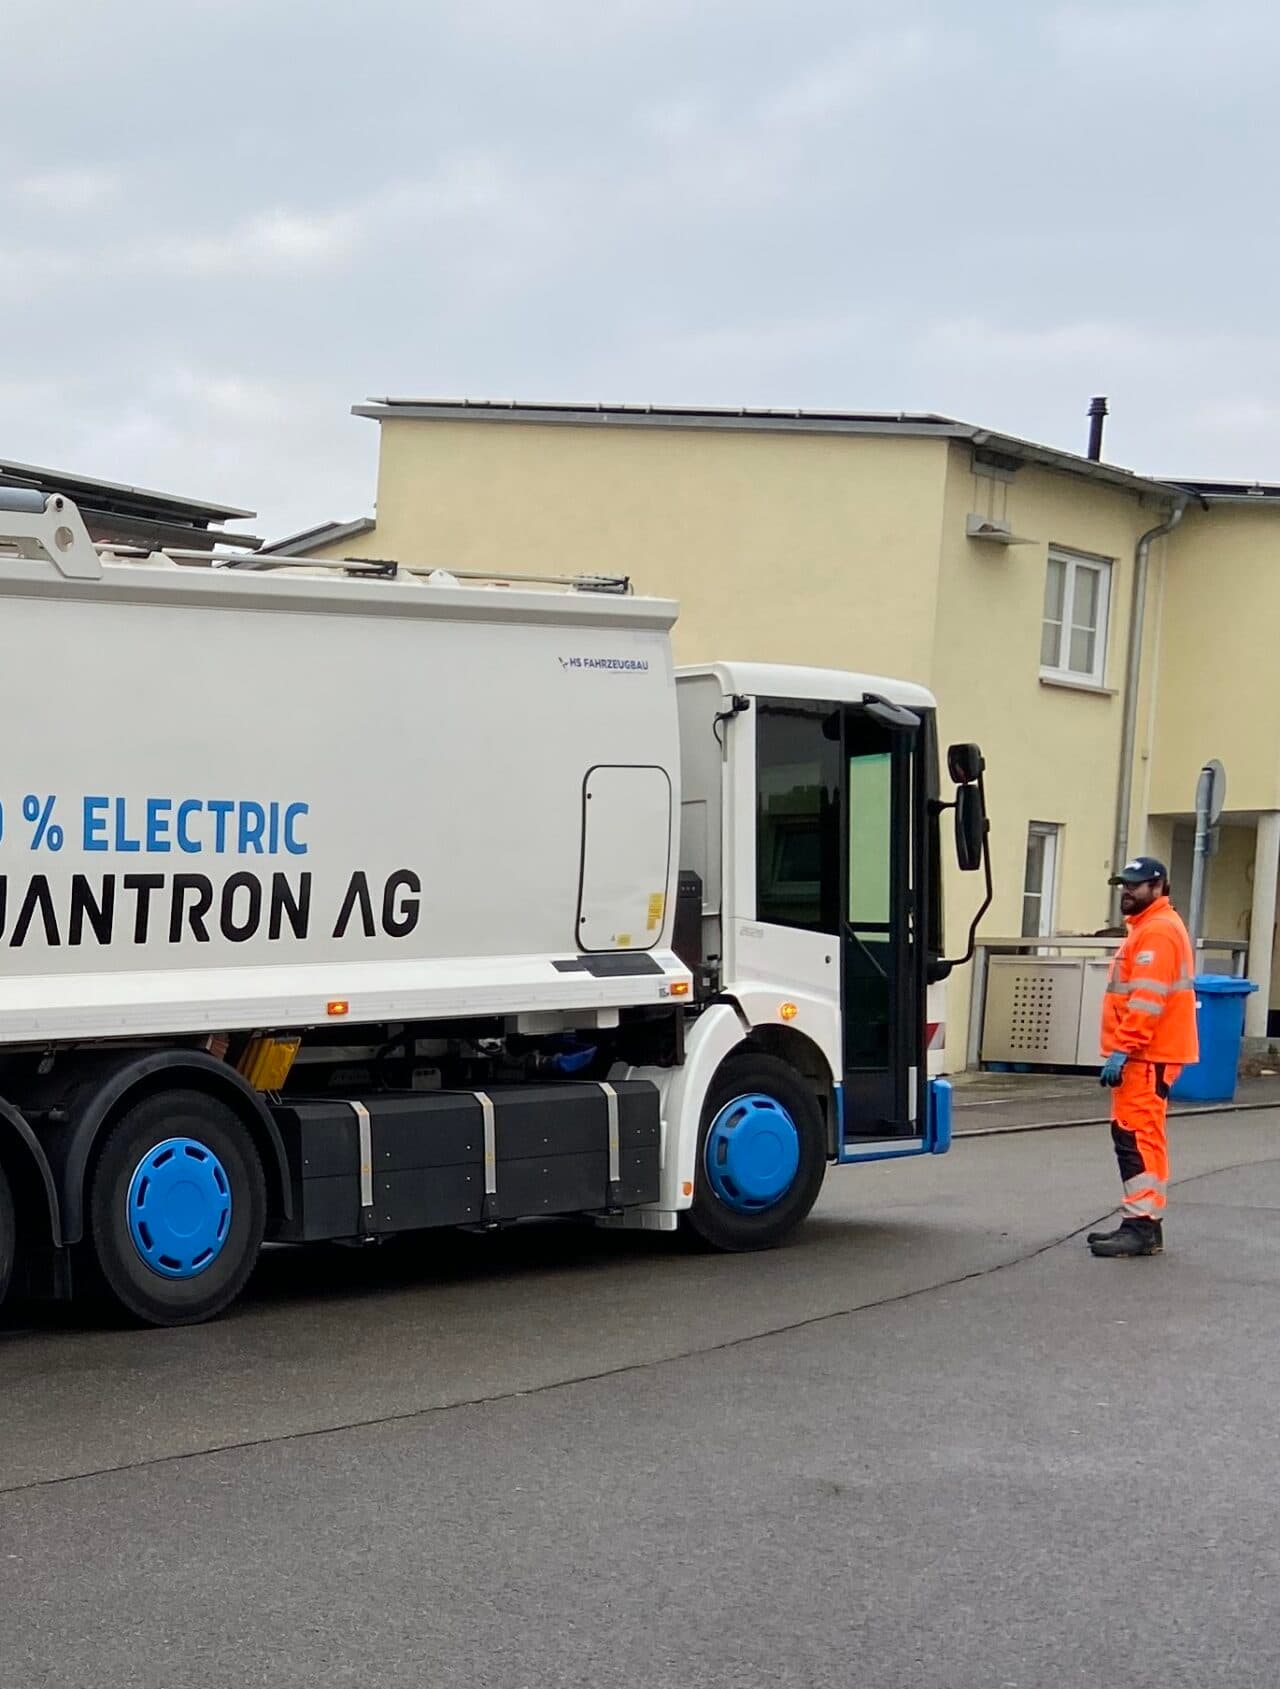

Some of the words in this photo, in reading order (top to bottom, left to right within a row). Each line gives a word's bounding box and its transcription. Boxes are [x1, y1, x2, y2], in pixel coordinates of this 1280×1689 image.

[569, 657, 582, 668] HS
[583, 658, 649, 670] FAHRZEUGBAU
[22, 795, 63, 852] %
[82, 796, 309, 855] ELECTRIC
[331, 868, 422, 938] AG
